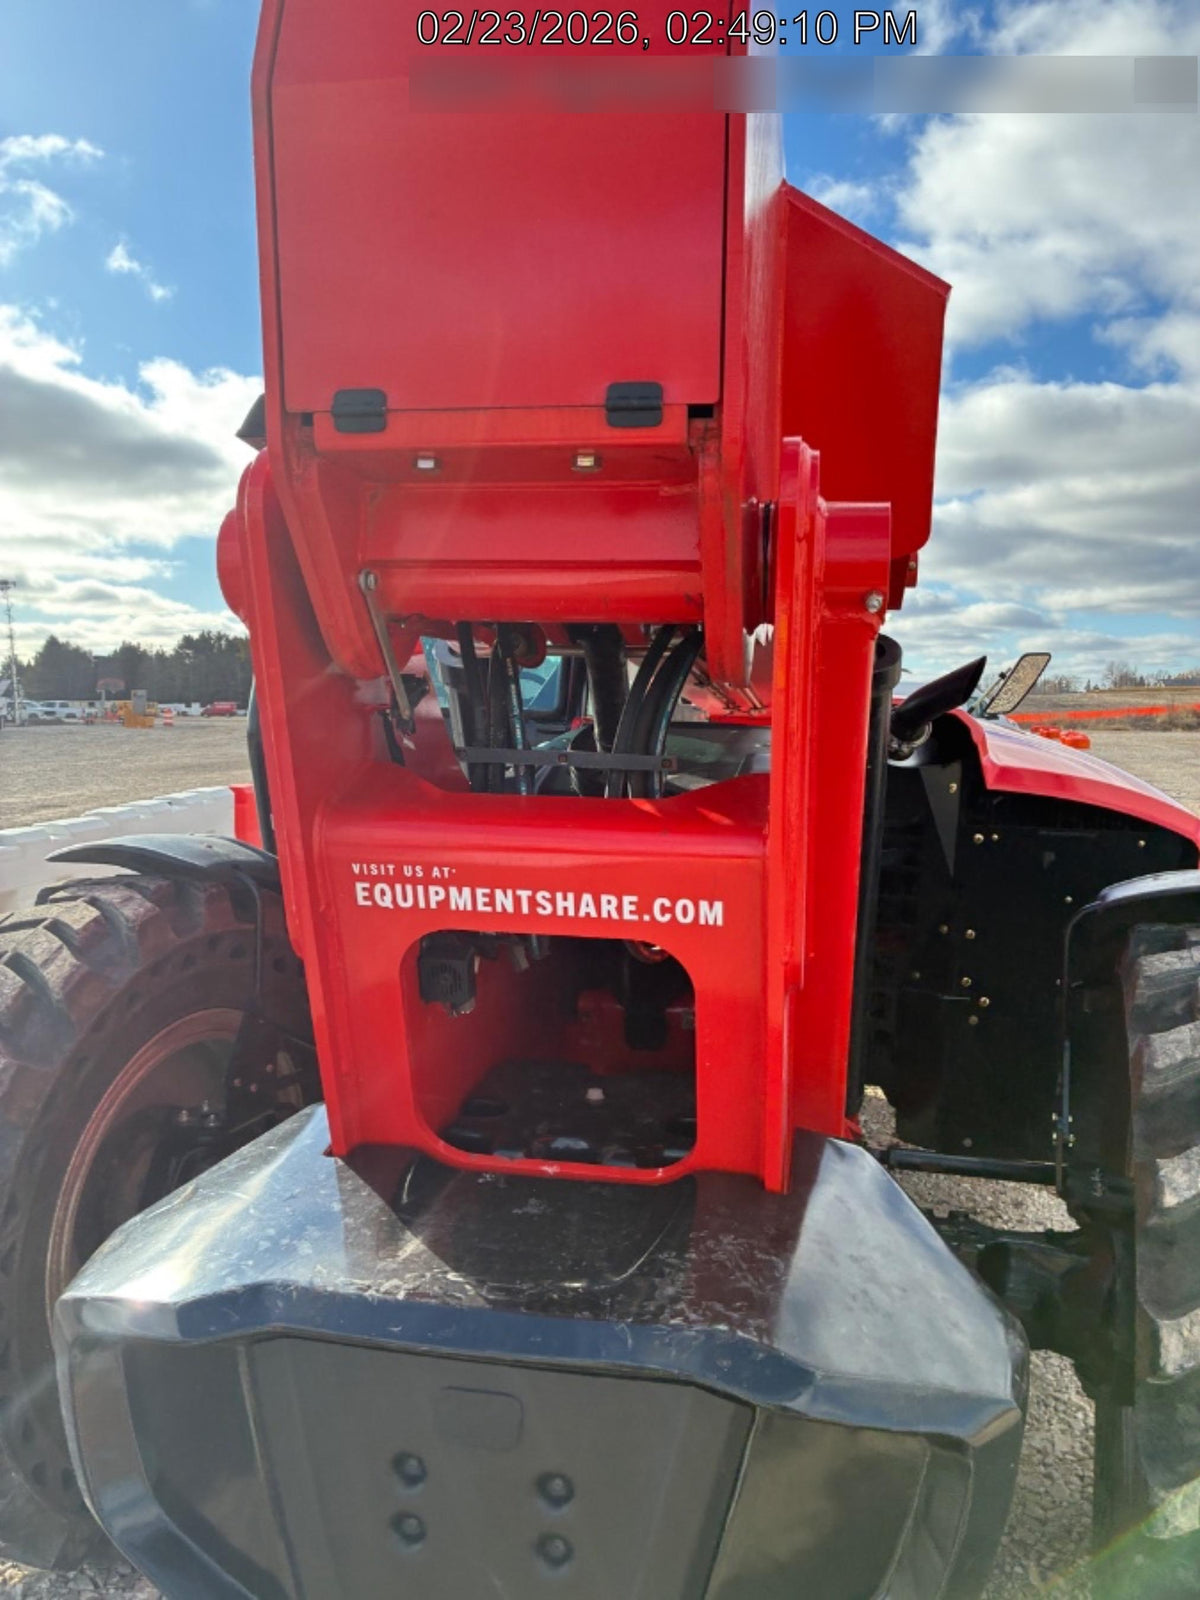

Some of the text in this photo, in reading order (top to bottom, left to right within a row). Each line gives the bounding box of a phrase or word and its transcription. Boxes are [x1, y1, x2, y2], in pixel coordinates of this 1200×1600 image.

[351, 863, 396, 876] VISIT
[403, 865, 424, 877] US
[354, 881, 724, 926] EQUIPMENTSHARE.COM
